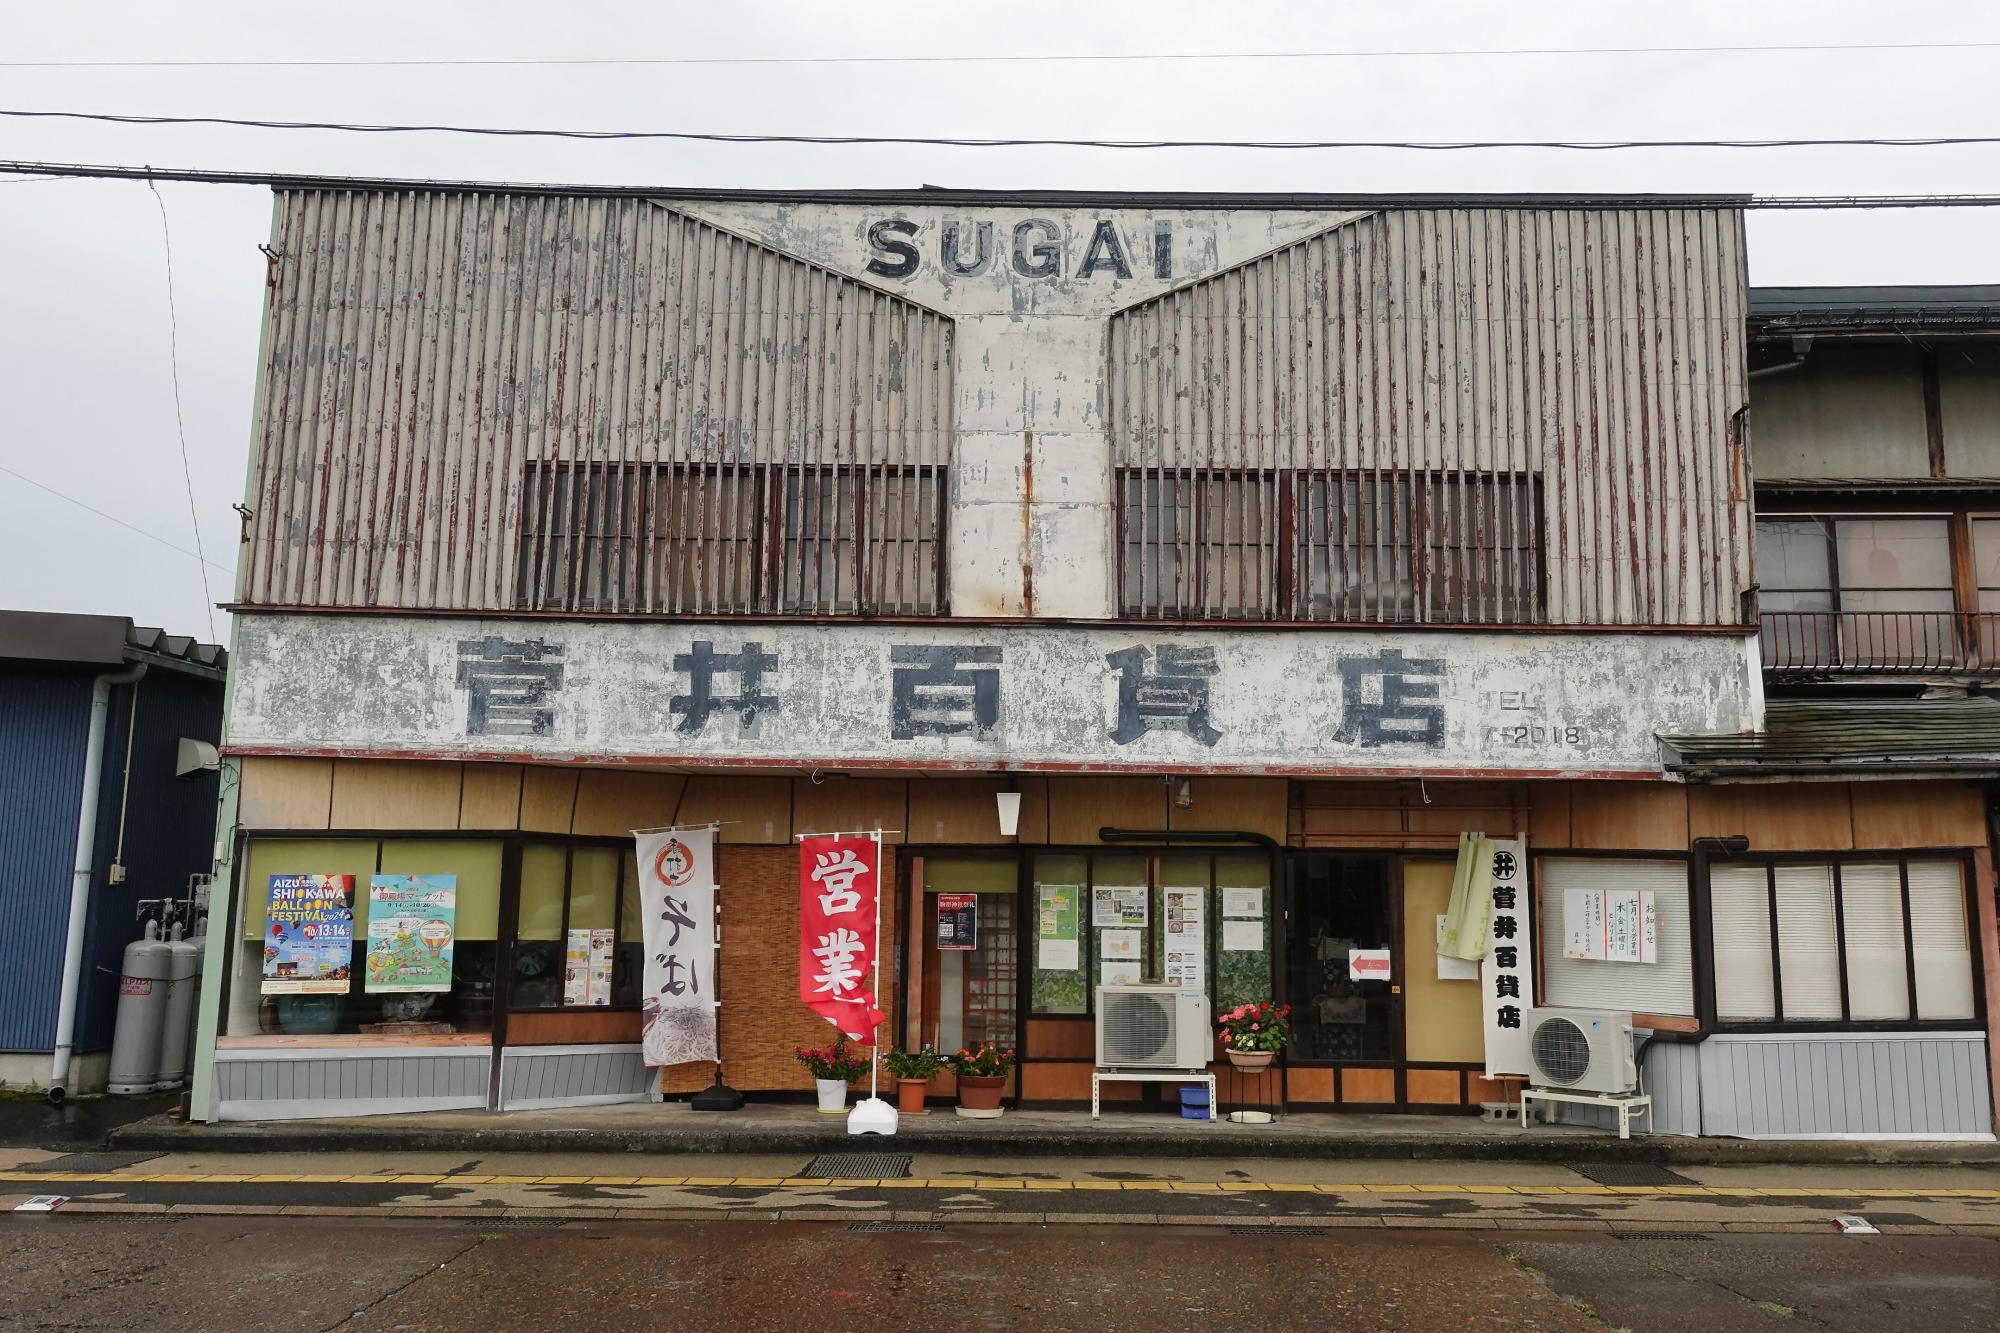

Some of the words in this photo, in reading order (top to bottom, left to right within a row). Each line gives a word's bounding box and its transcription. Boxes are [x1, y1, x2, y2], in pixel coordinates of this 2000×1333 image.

[865, 217, 1172, 280] SUGAI
[456, 634, 1446, 749] 菅井百貨店
[272, 888, 345, 900] SHIOKAWA
[273, 879, 300, 888] AIZU
[271, 911, 325, 922] FESTIVAL
[272, 899, 333, 911] BALLOON
[1616, 902, 1627, 951] 木金土曜日
[1645, 903, 1655, 944] お知らせ
